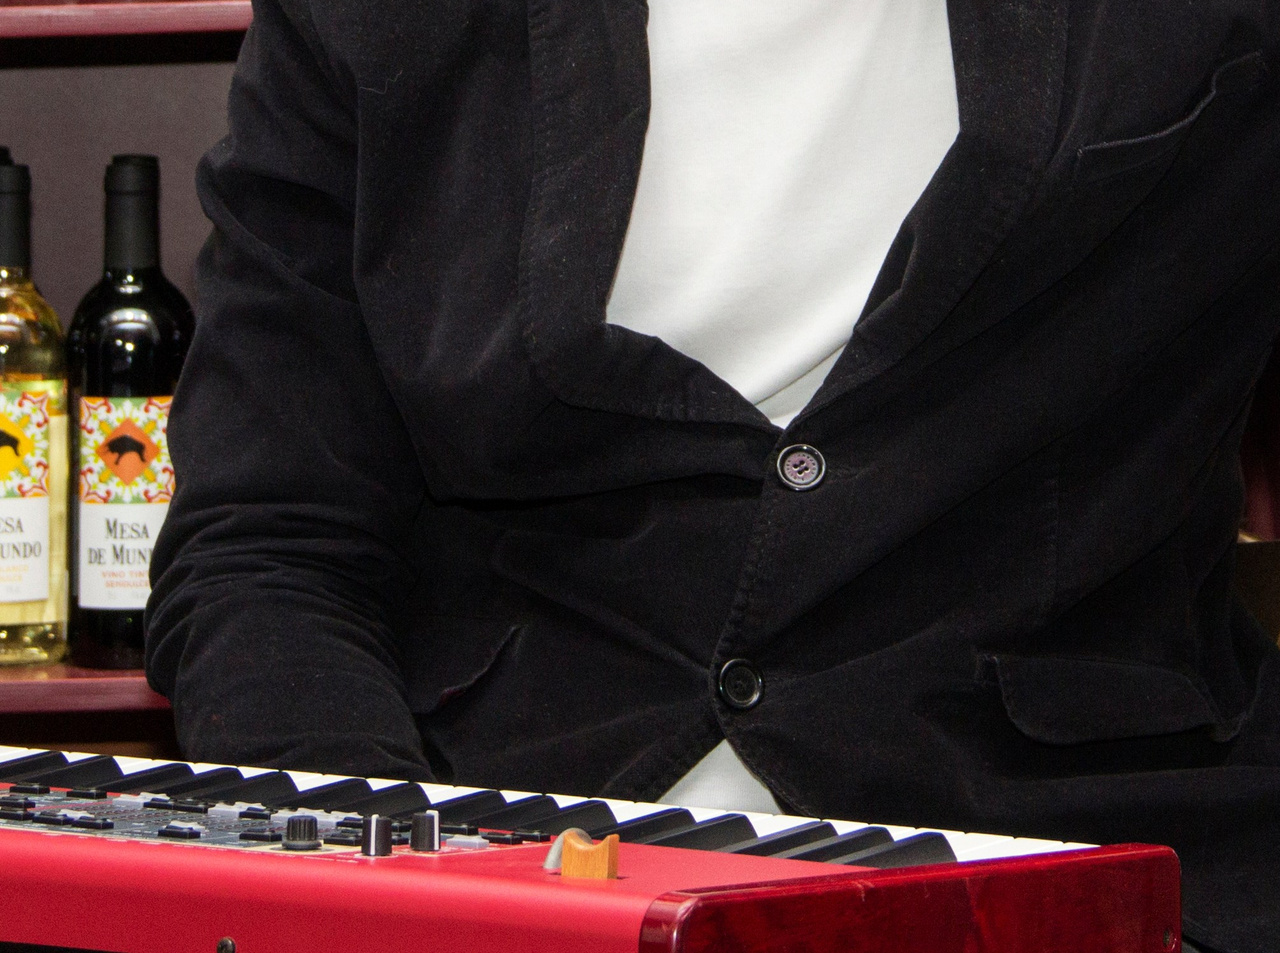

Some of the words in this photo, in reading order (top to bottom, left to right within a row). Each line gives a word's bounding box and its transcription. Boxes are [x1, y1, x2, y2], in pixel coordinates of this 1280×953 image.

[105, 518, 150, 541] MESA
[0, 542, 43, 560] UNDO
[88, 548, 106, 566] DE
